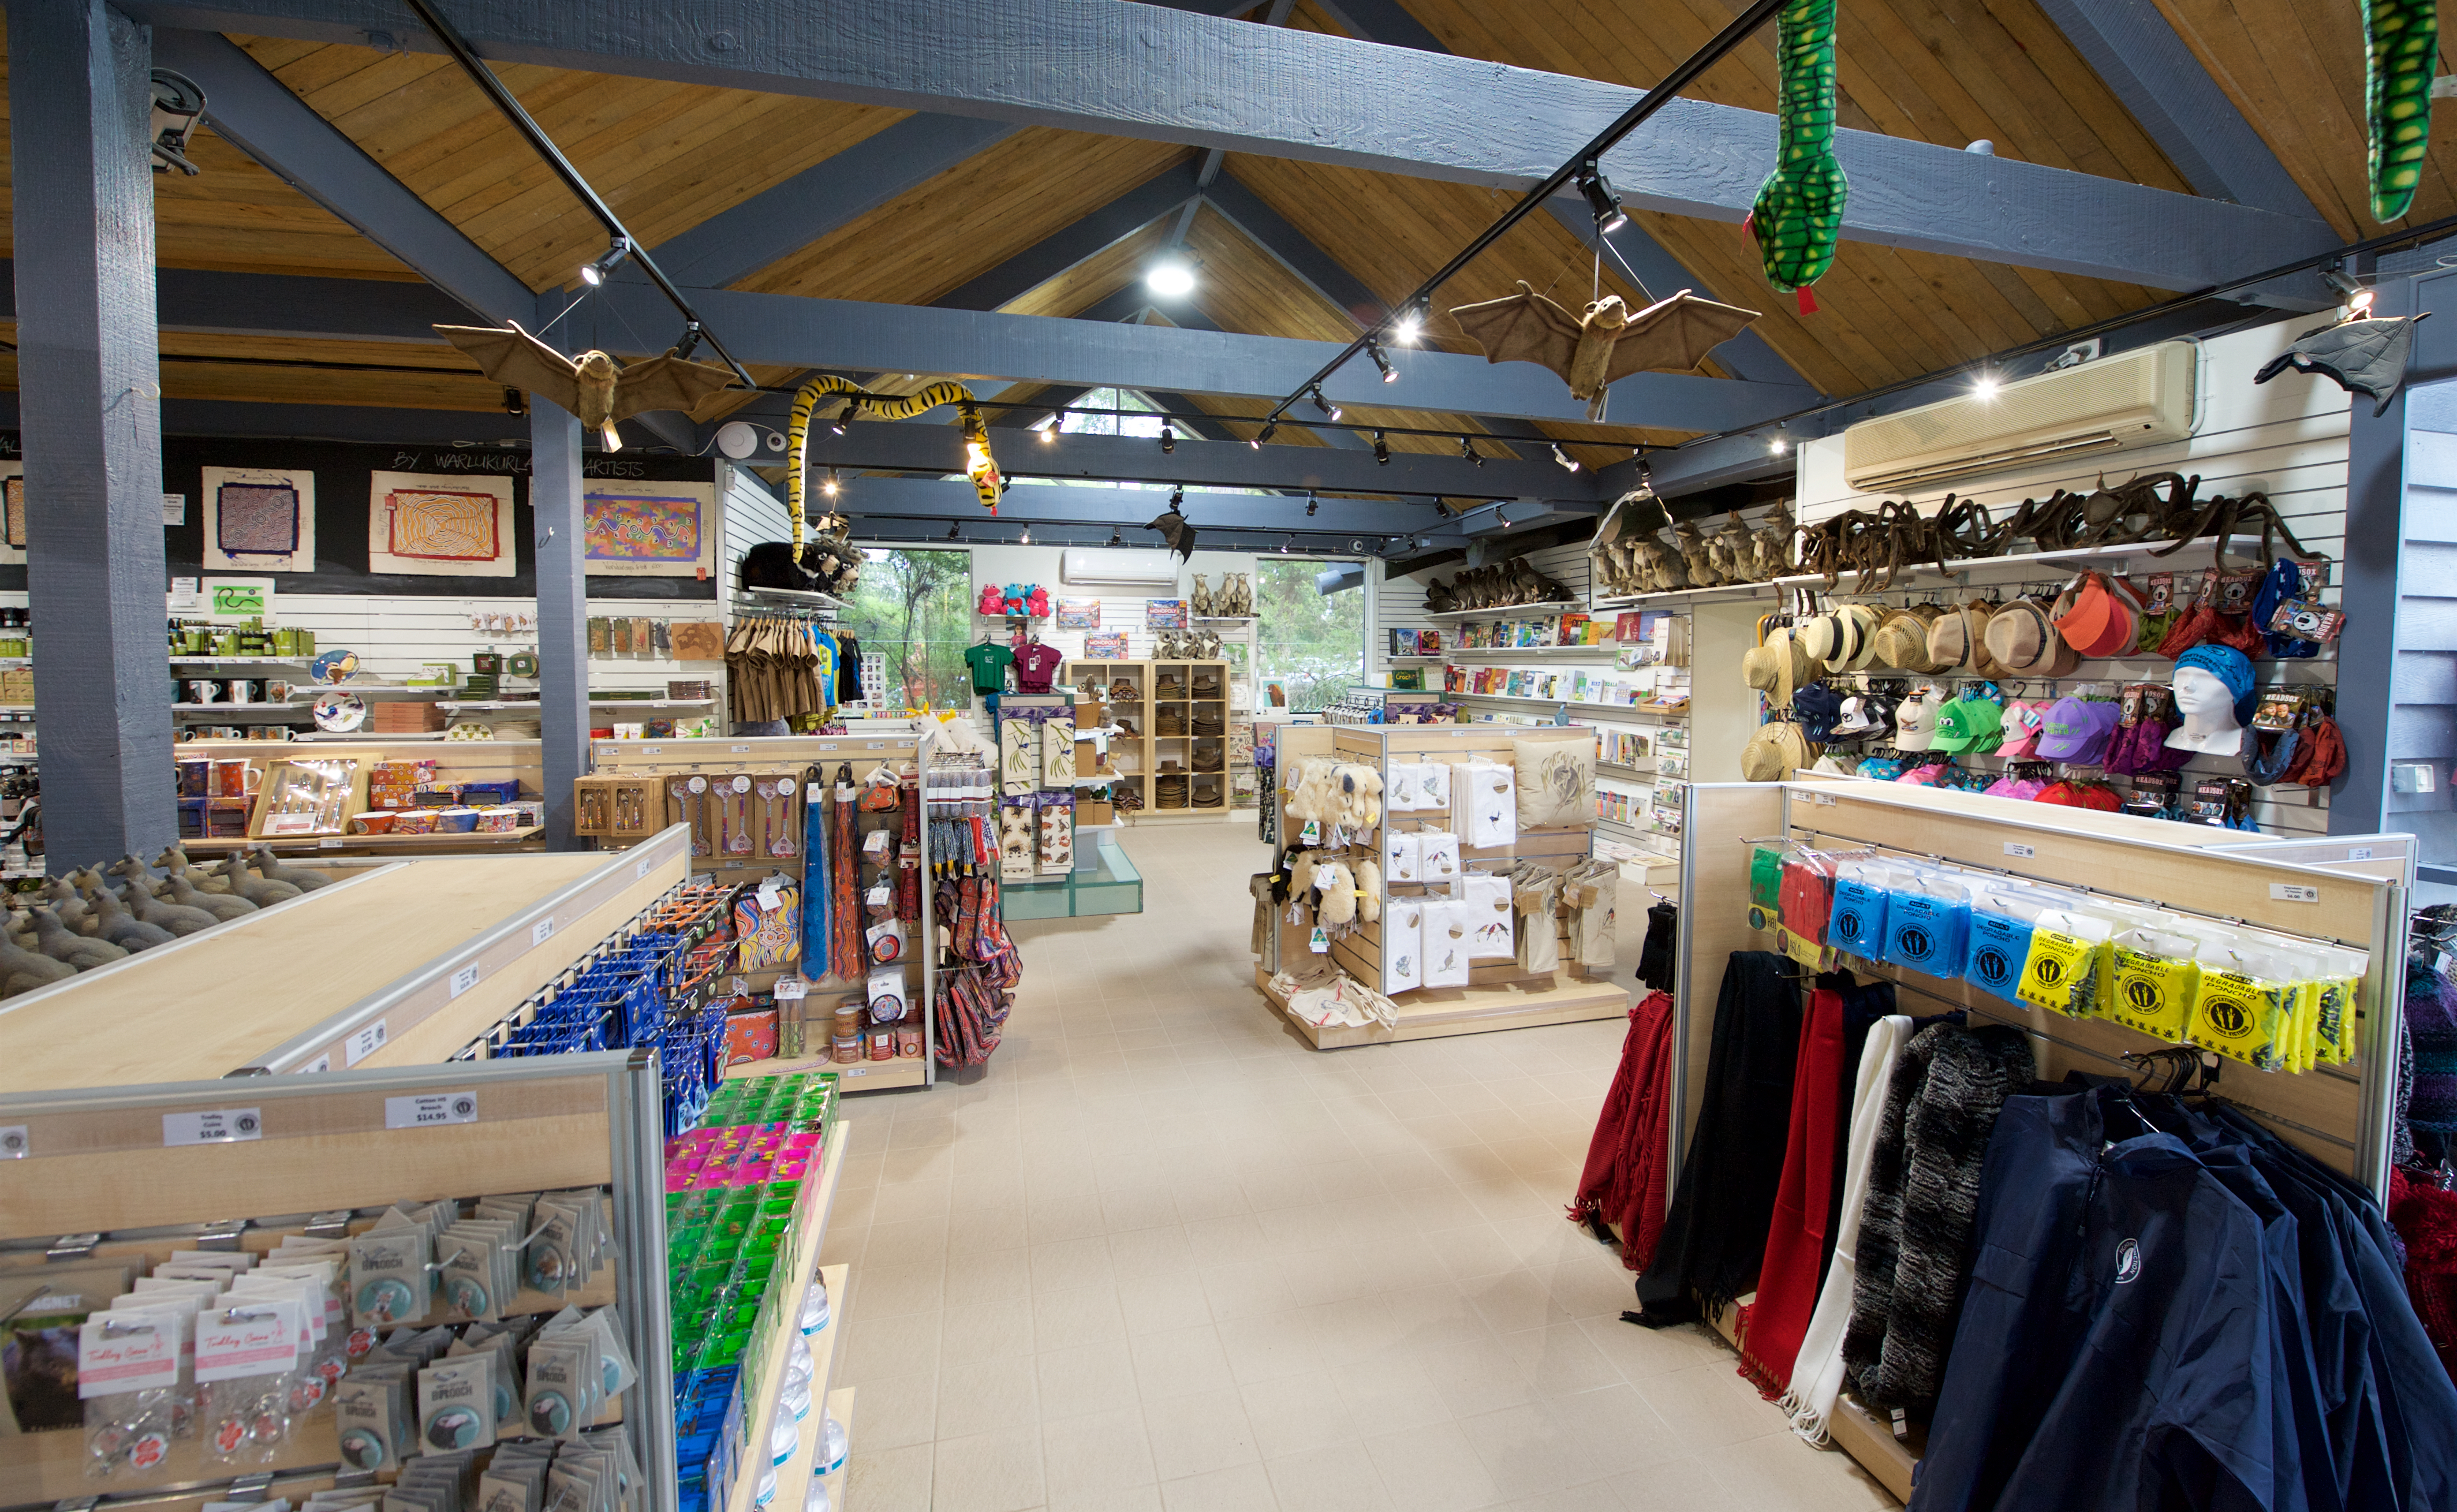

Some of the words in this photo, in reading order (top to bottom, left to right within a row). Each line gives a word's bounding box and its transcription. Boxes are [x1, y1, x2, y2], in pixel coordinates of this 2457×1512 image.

[392, 454, 421, 469] BY
[583, 458, 644, 477] ARTISTS
[2313, 612, 2335, 639] HEADSOX
[2265, 694, 2299, 703] HEADSOX
[2136, 776, 2163, 785] HEADSOX
[2198, 786, 2224, 794] HEADSOX
[1839, 891, 1871, 902] DEGRADABLE
[1844, 897, 1864, 905] PONCHO
[1897, 905, 1940, 917] DEGRADABLE
[1904, 911, 1931, 920] PONCHO
[1767, 916, 1777, 929] HAL
[1977, 924, 2020, 940] DEGRADABLE
[1983, 931, 2010, 942] PONCHO
[2038, 937, 2080, 953] DEGRADABLE
[2039, 943, 2074, 956] PONCHO
[2122, 957, 2170, 973] DEGRADABLE
[2124, 964, 2165, 977] PONCHO
[2205, 976, 2263, 995] DEGRADABLE
[2206, 983, 2257, 1000] PONCHO
[2217, 997, 2247, 1013] EXTINCTION
[417, 1112, 447, 1121] $14.95
[200, 1130, 226, 1138] $5.00
